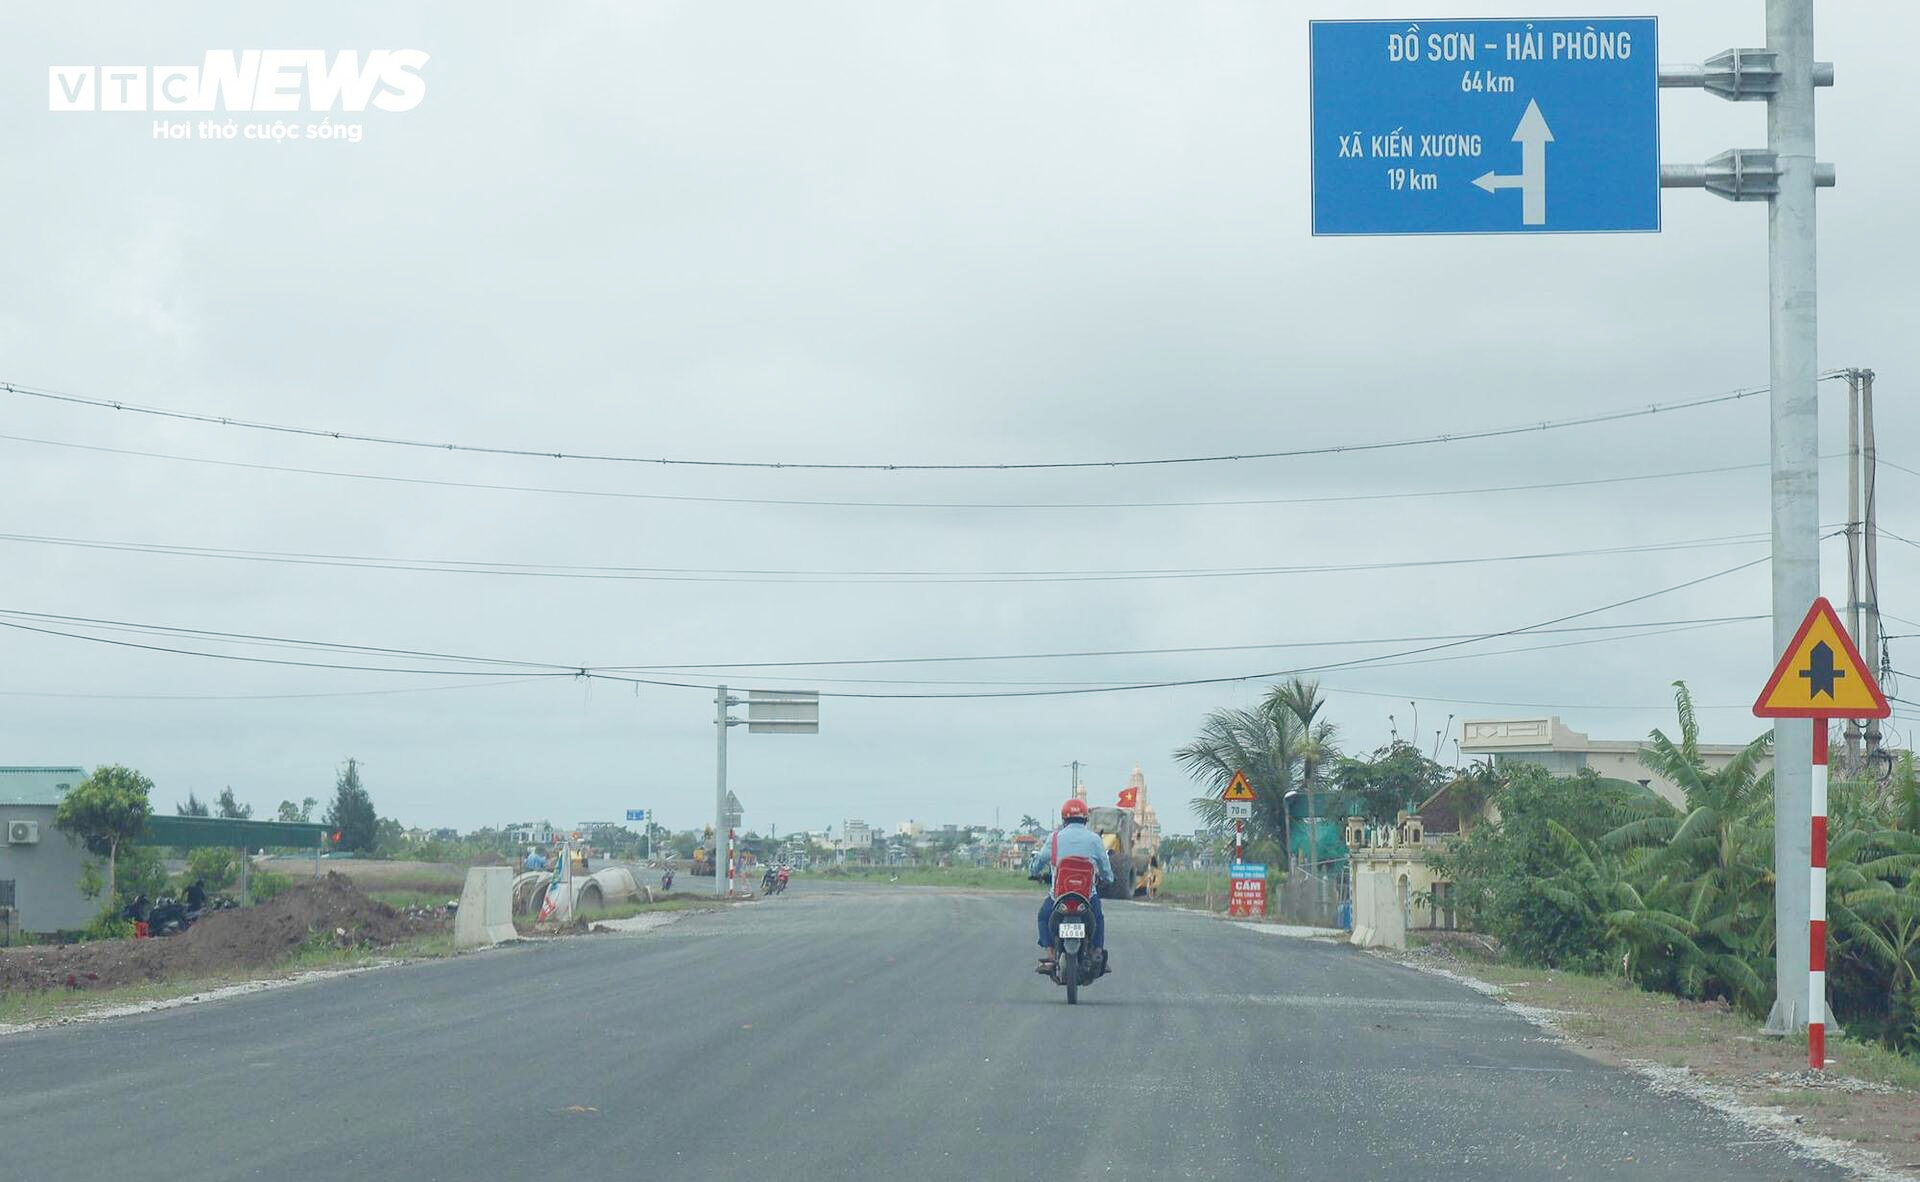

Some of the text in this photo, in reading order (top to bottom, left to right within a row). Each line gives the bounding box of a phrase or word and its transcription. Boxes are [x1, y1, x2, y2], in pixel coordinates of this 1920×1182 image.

[1388, 24, 1420, 61] ĐỒ
[1427, 32, 1475, 61] SƠN
[1505, 24, 1544, 60] HẢI
[1552, 26, 1632, 60] PHÒNG
[1461, 70, 1515, 93] 64 km
[1338, 126, 1482, 158] XÃ KIẾN XƯƠNG
[1387, 168, 1438, 190] 19 km
